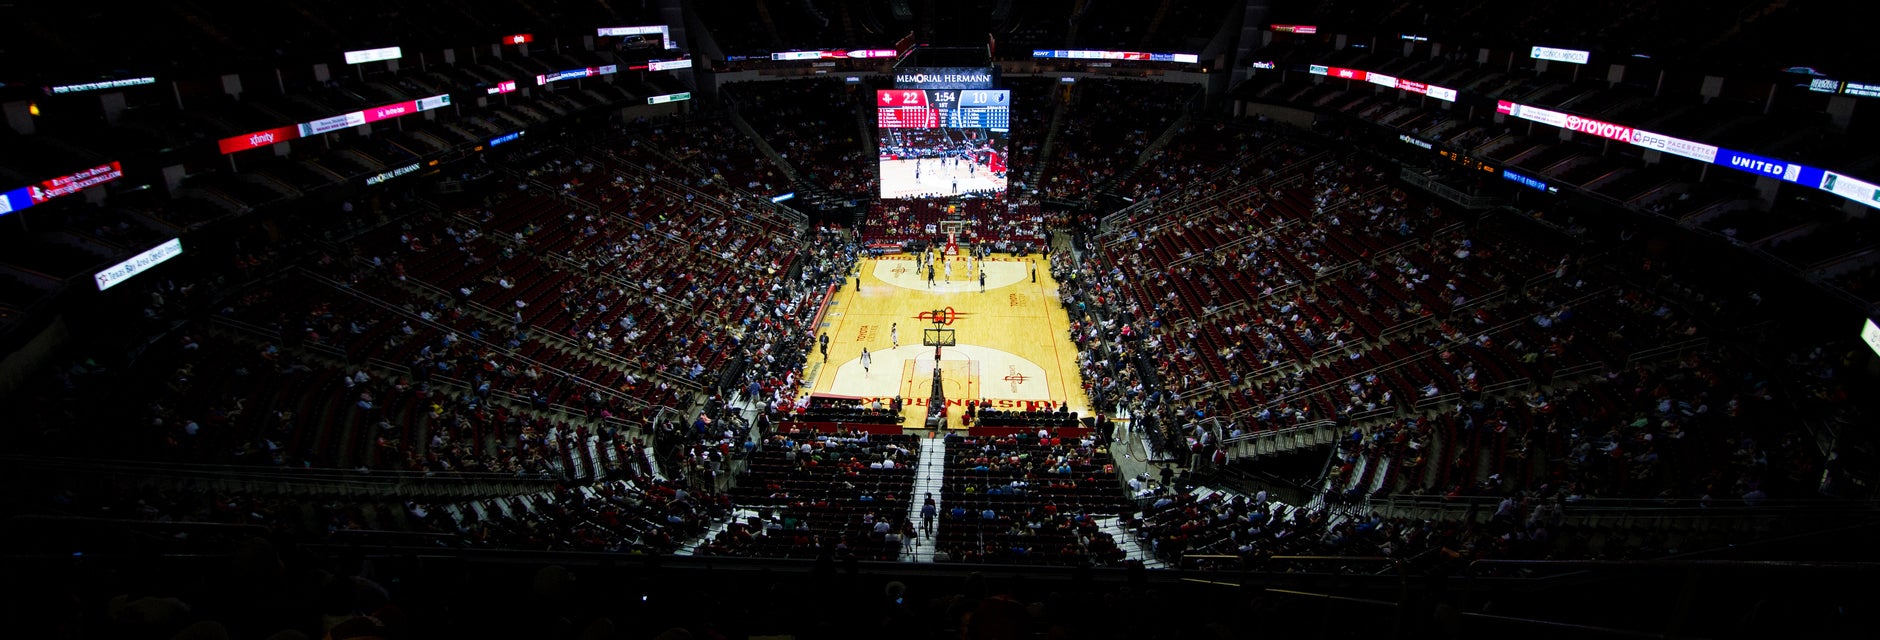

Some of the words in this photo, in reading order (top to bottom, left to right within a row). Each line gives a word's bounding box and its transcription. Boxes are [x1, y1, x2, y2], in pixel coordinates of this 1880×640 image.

[896, 73, 942, 84] MEMORIAL
[944, 74, 990, 83] HERMANN
[903, 92, 918, 104] 22
[935, 92, 955, 102] 1:54
[973, 92, 988, 104] 10
[1580, 118, 1631, 143] TOYOTA
[250, 132, 274, 146] xfinity
[1642, 135, 1666, 148] PPS
[1731, 156, 1783, 175] UNITED
[366, 170, 394, 186] MEMORIAL
[394, 163, 420, 177] HERMANN
[107, 268, 126, 282] Texas
[125, 263, 136, 275] Bay
[149, 250, 164, 262] Credit
[857, 325, 868, 341] TOYOTA
